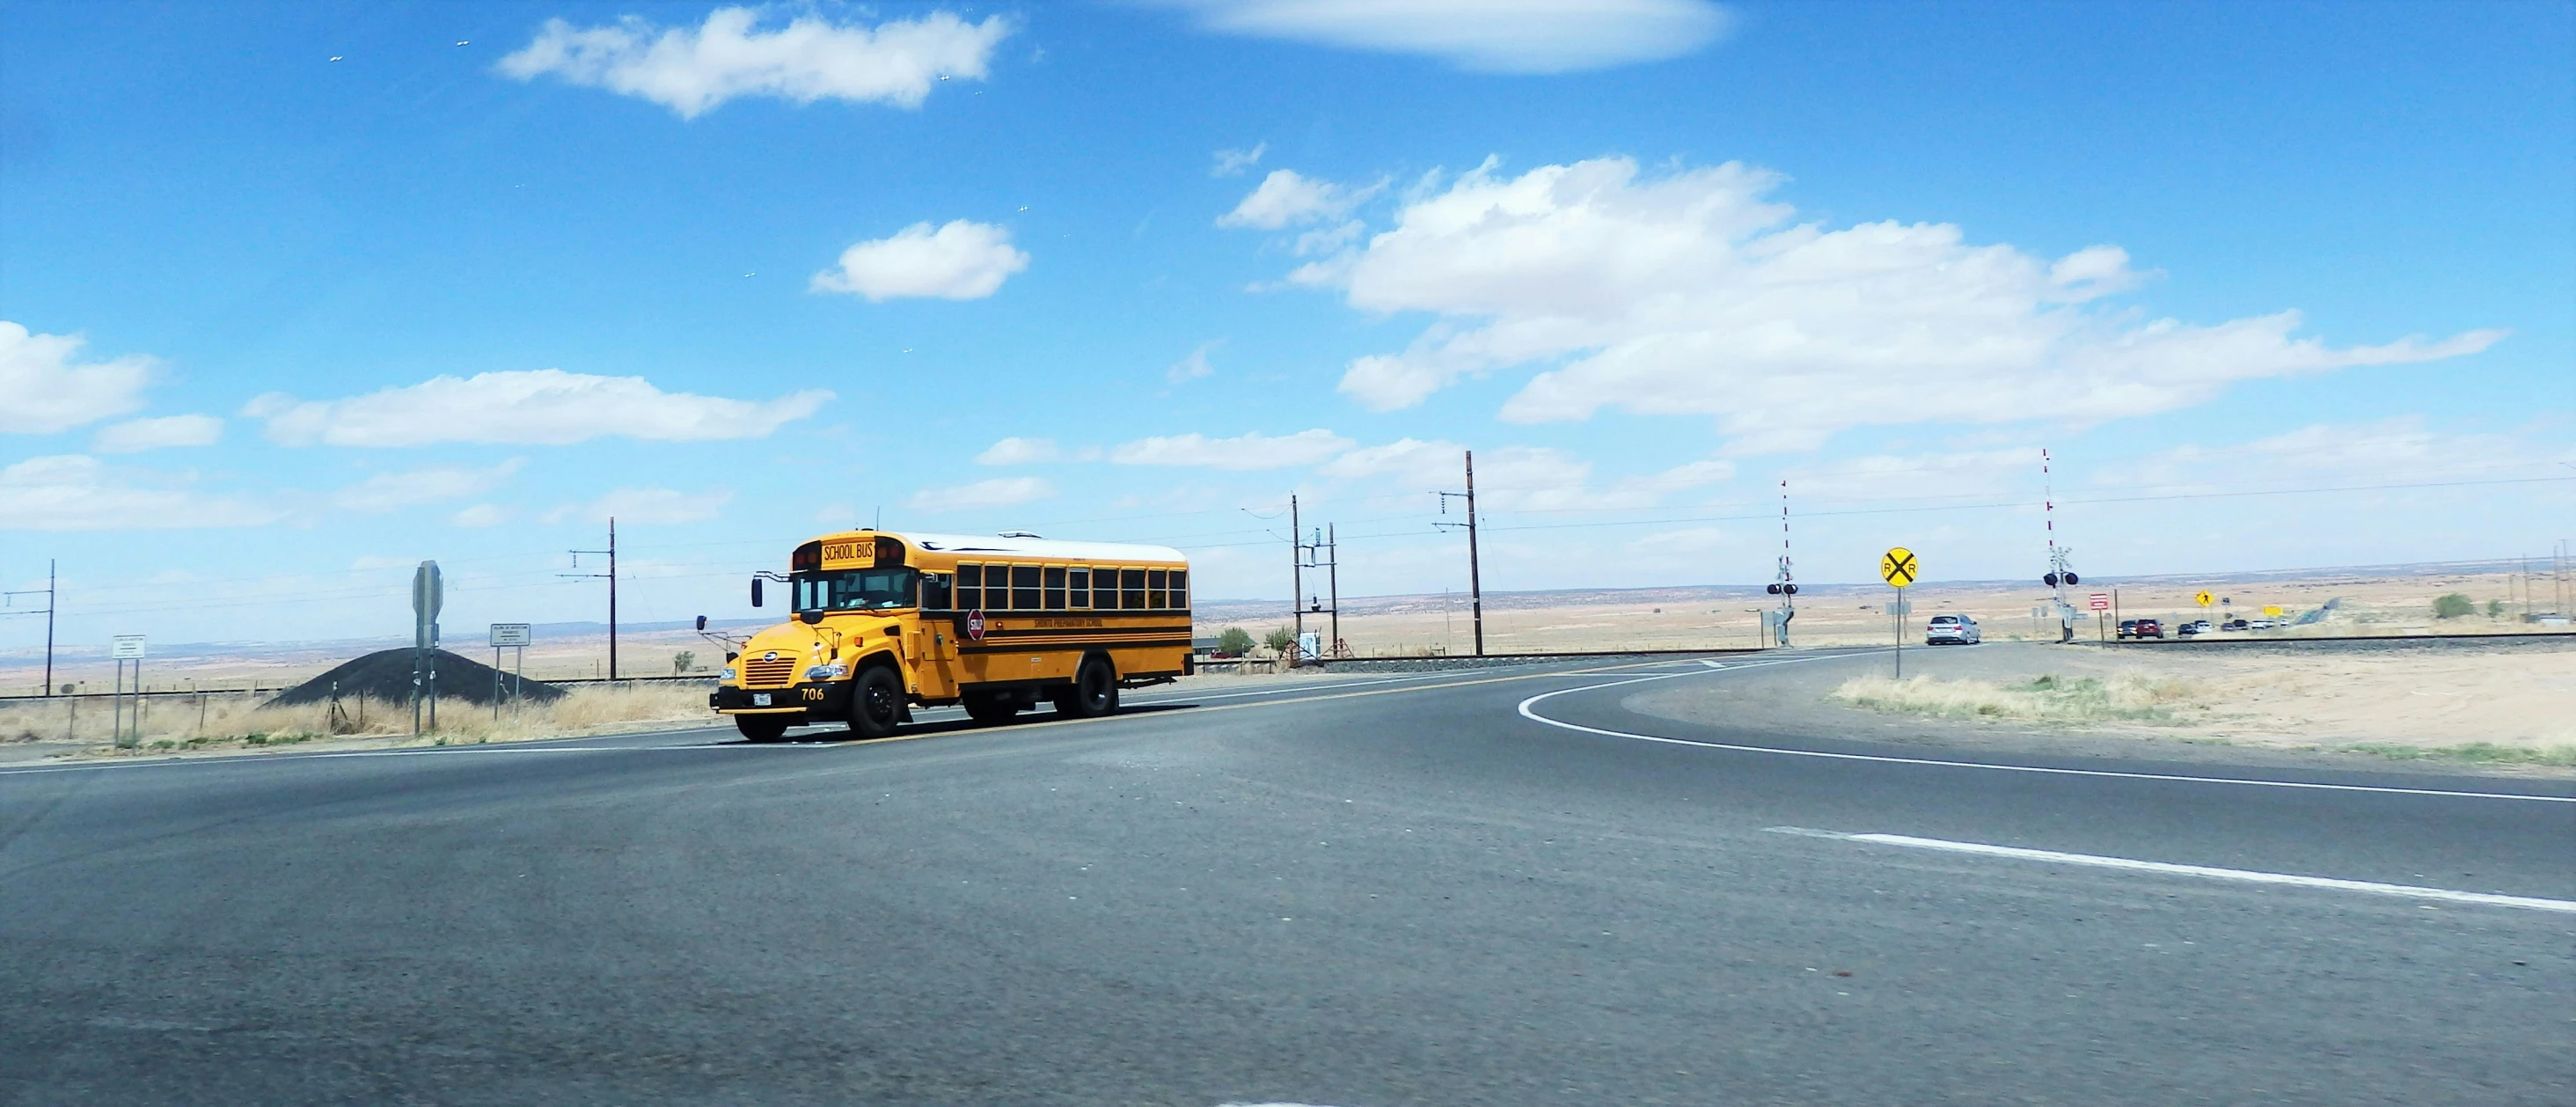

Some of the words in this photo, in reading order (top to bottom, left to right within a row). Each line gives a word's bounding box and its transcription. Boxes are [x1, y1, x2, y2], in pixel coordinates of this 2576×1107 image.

[824, 545, 854, 561] SCHOOL
[857, 543, 873, 559] BUS
[1884, 563, 1891, 572] R
[1908, 564, 1916, 573] R
[970, 619, 983, 630] STOP
[1087, 618, 1103, 627] SCHOOL
[801, 688, 824, 700] 706
